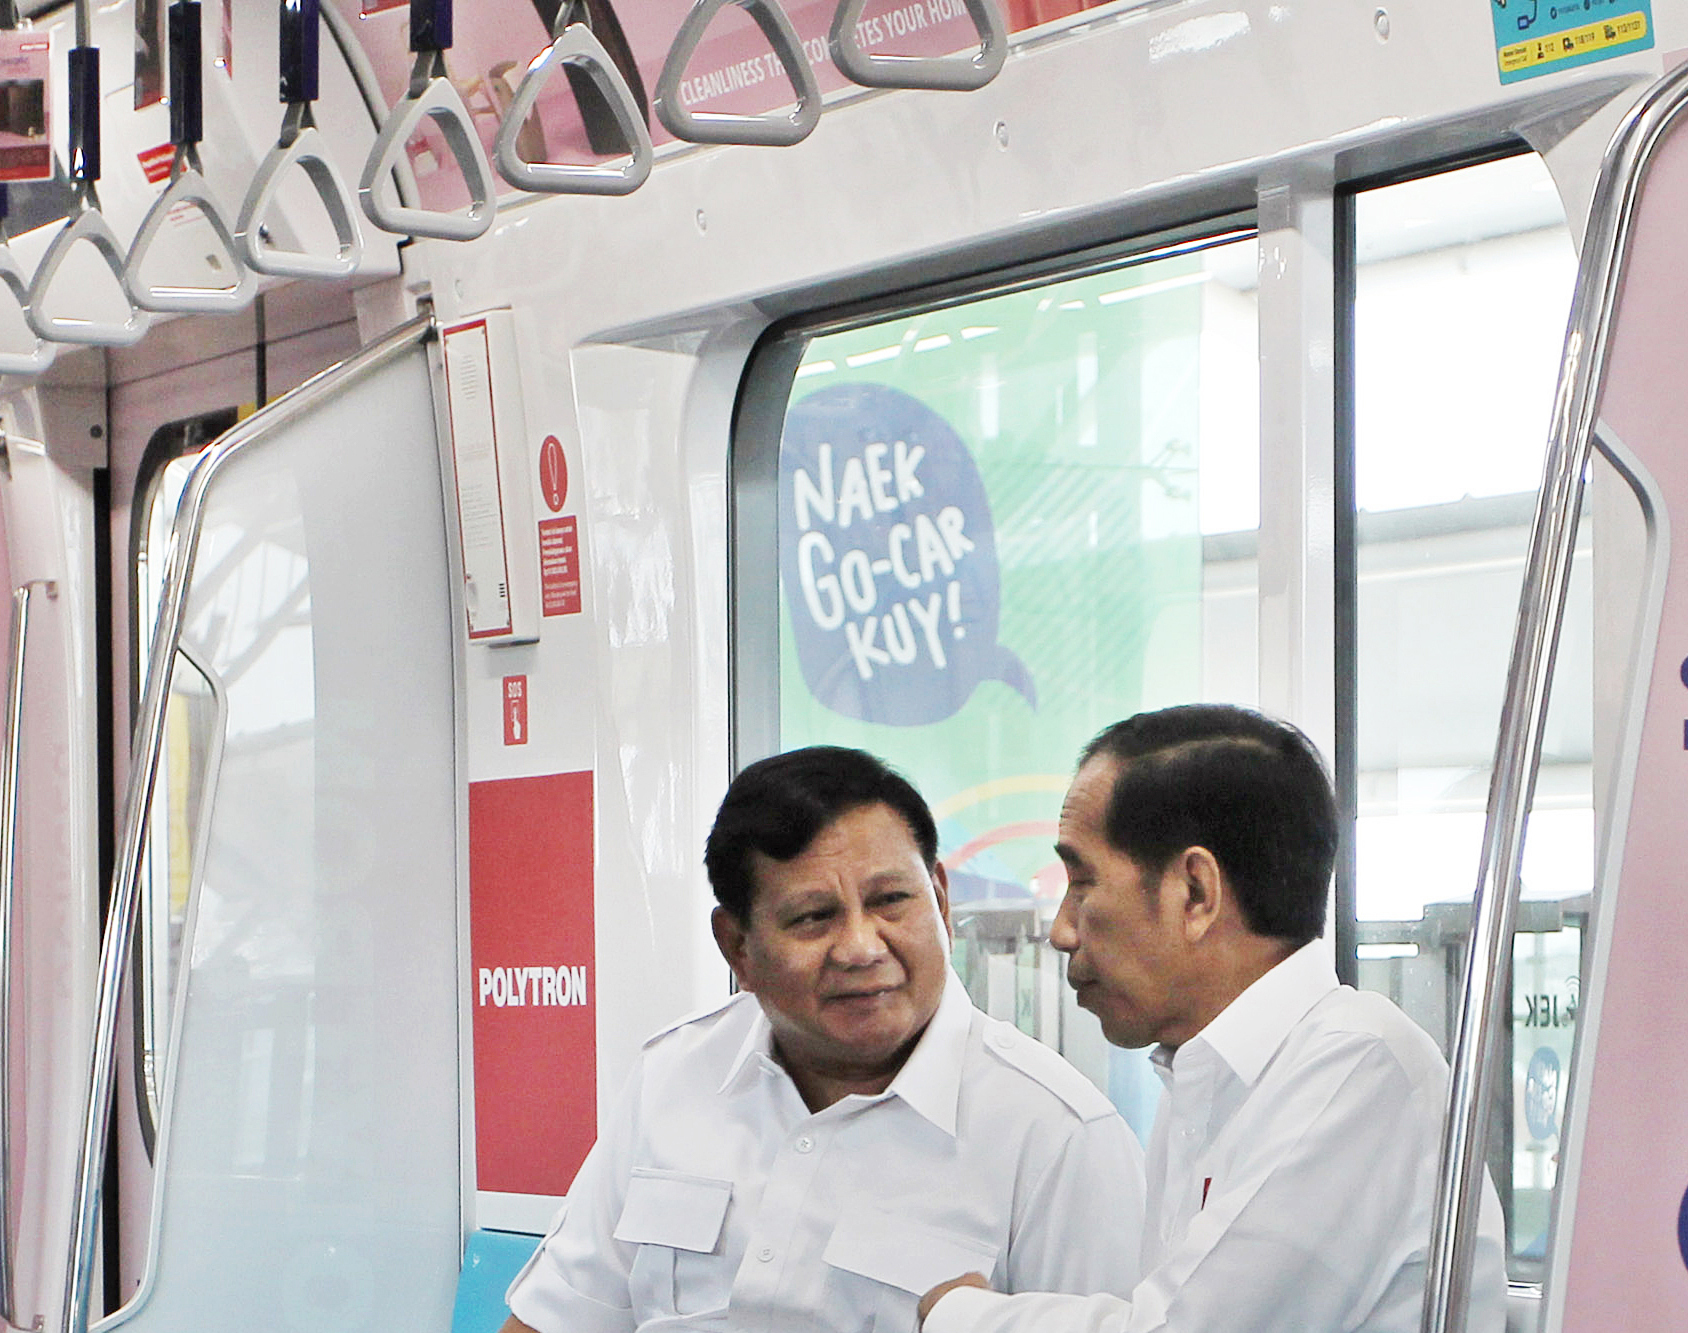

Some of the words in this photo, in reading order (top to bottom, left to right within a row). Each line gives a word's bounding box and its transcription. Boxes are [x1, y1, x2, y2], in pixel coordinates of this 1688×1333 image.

[681, 58, 766, 105] CLEANLINESS
[762, 52, 785, 82] TH
[882, 10, 926, 39] YOUR
[921, 0, 968, 29] HOM
[793, 440, 926, 531] NAEK
[798, 505, 976, 631] GO-CAR
[845, 580, 966, 681] KUY!
[508, 681, 522, 698] SOS
[479, 965, 587, 1008] POLYTRON
